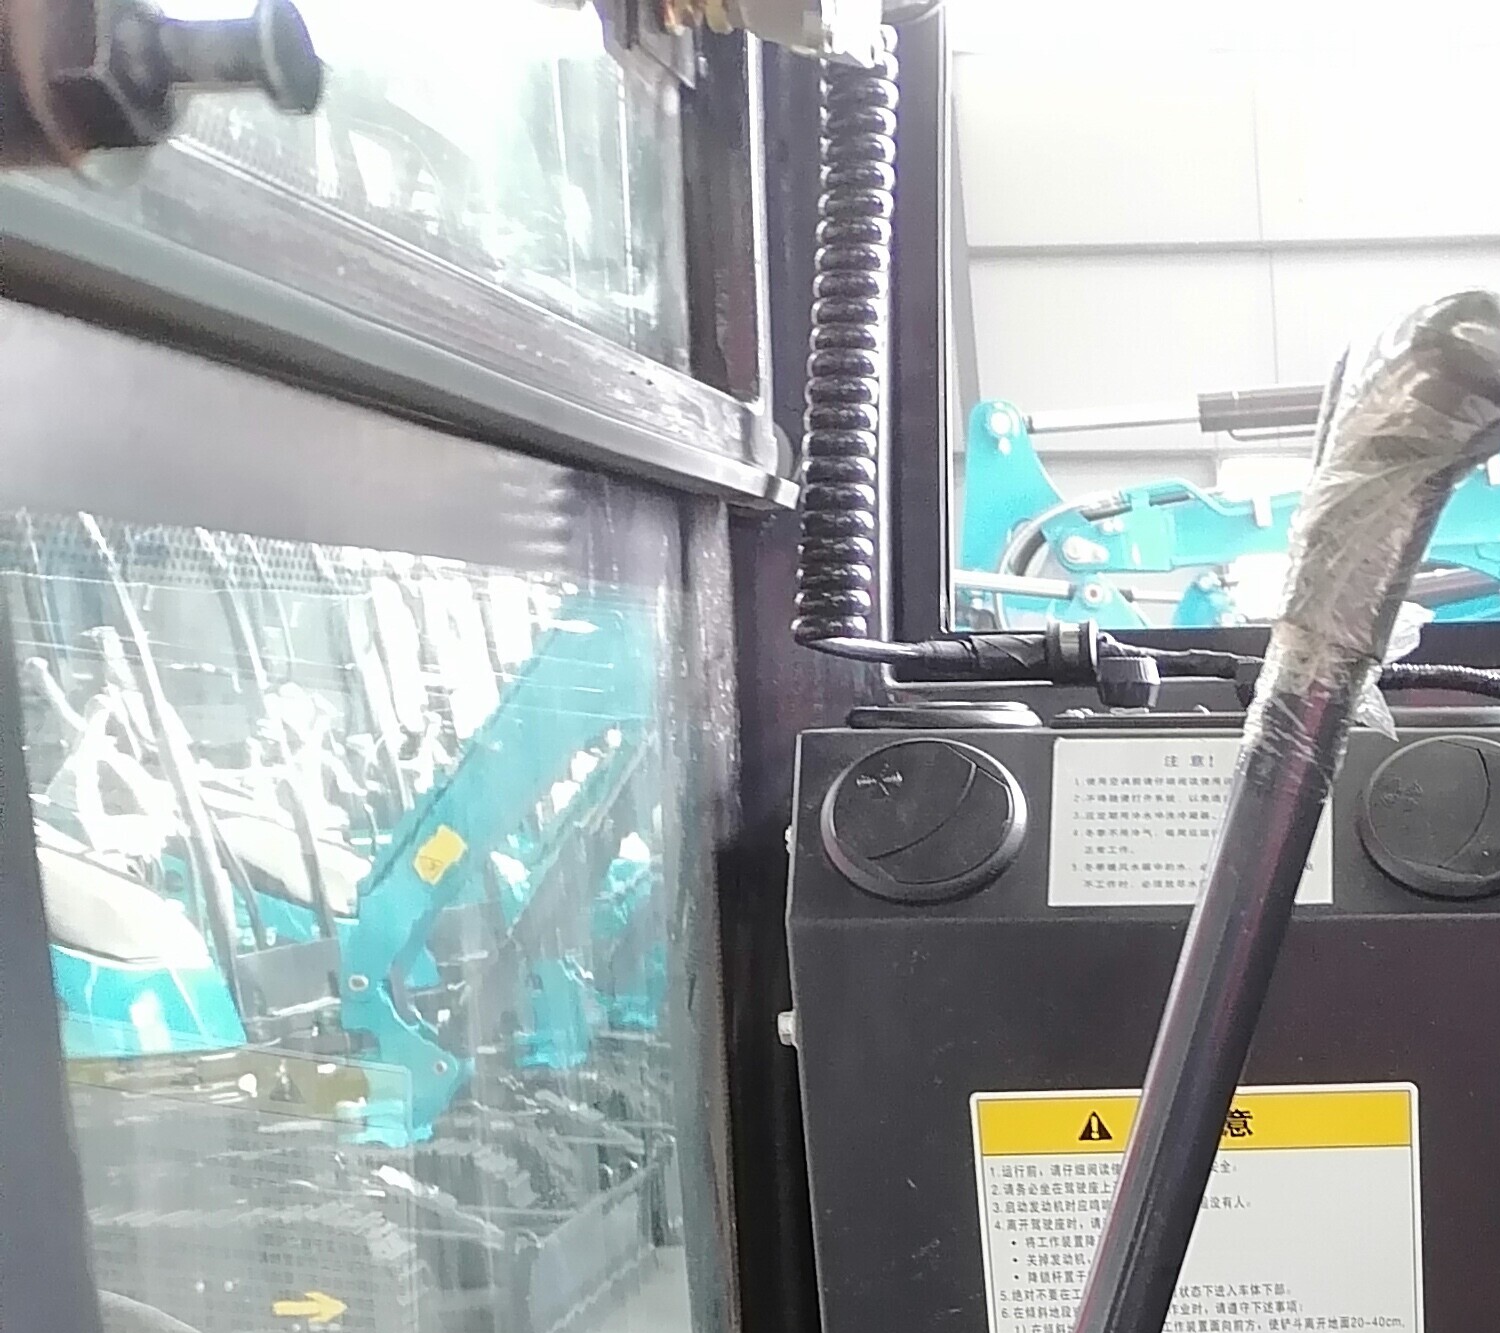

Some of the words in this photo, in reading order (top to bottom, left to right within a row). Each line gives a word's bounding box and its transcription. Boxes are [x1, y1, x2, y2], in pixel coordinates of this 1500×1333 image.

[990, 1181, 1116, 1196] 2.请务必坐在驾驶座上
[994, 1216, 1106, 1232] 4.离开驾驶座时，请
